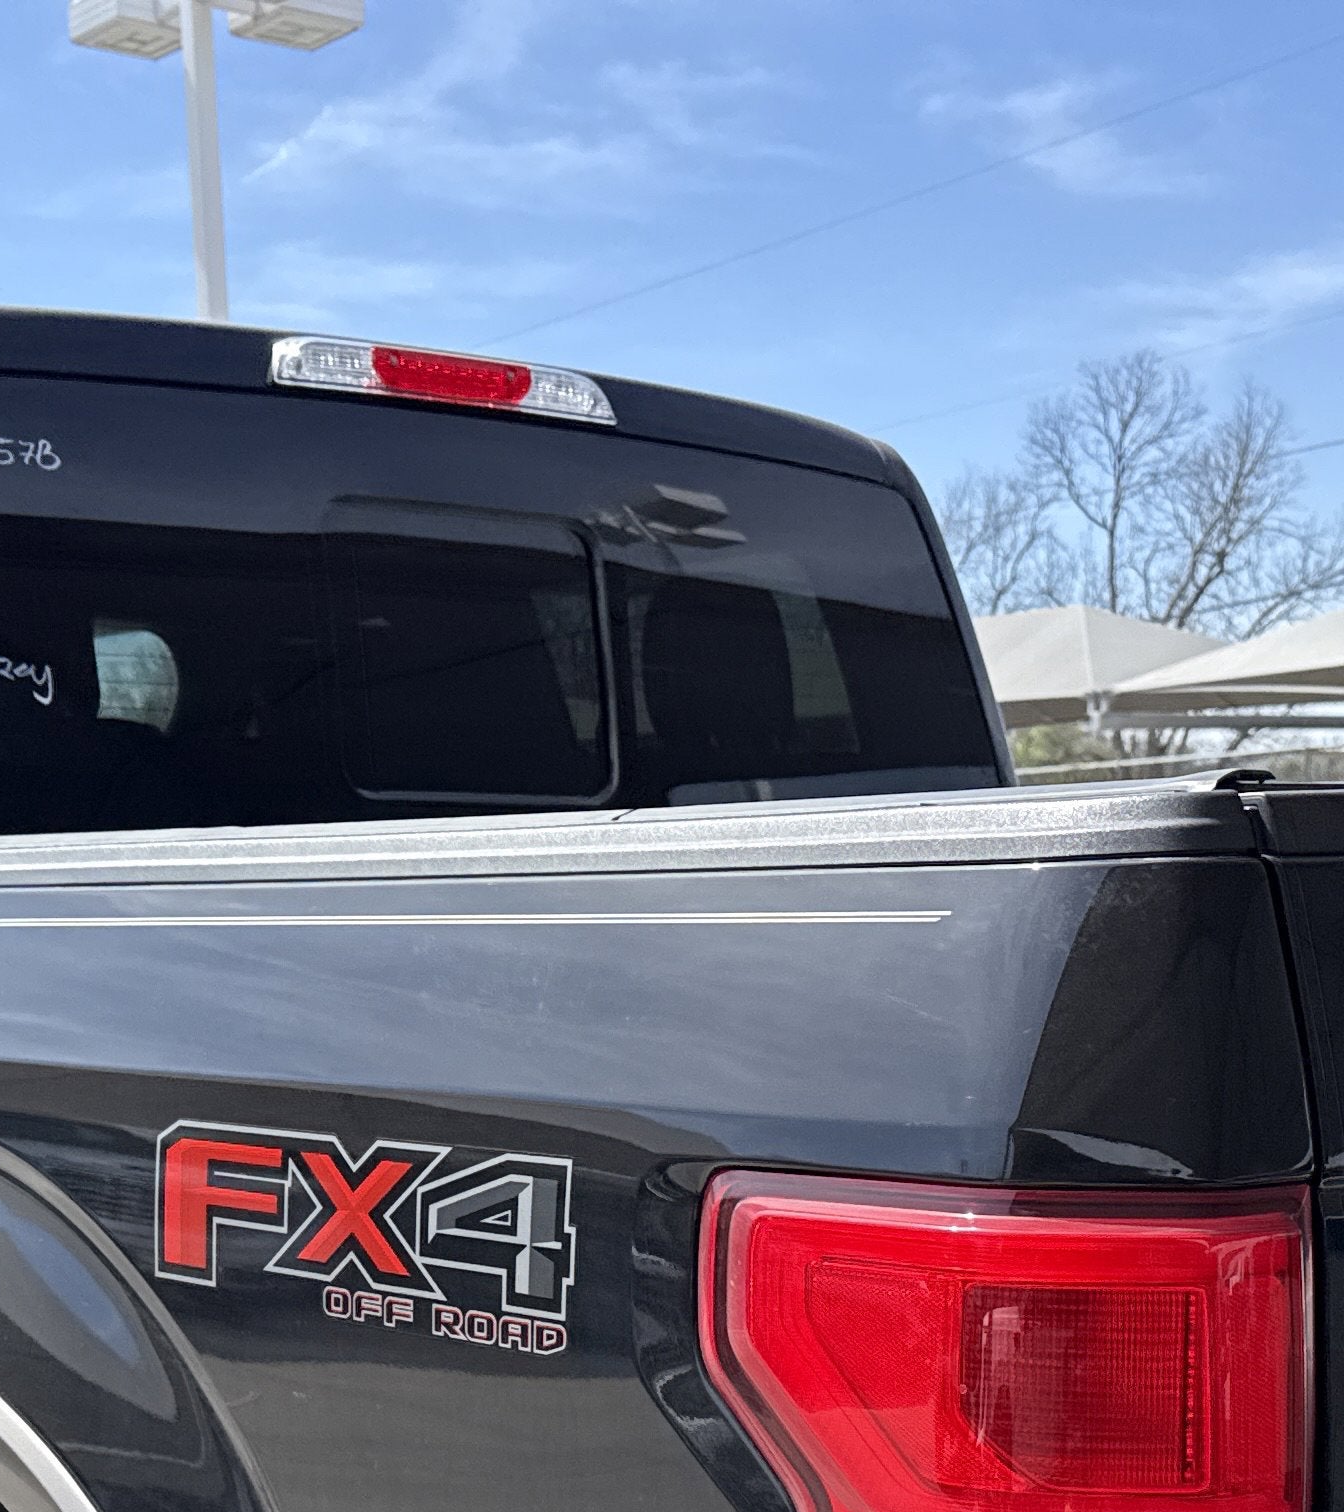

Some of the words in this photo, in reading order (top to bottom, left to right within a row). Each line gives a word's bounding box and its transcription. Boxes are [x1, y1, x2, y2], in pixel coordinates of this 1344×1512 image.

[155, 1118, 577, 1321] FX4
[321, 1284, 415, 1328] OFF
[431, 1300, 568, 1356] ROAD
